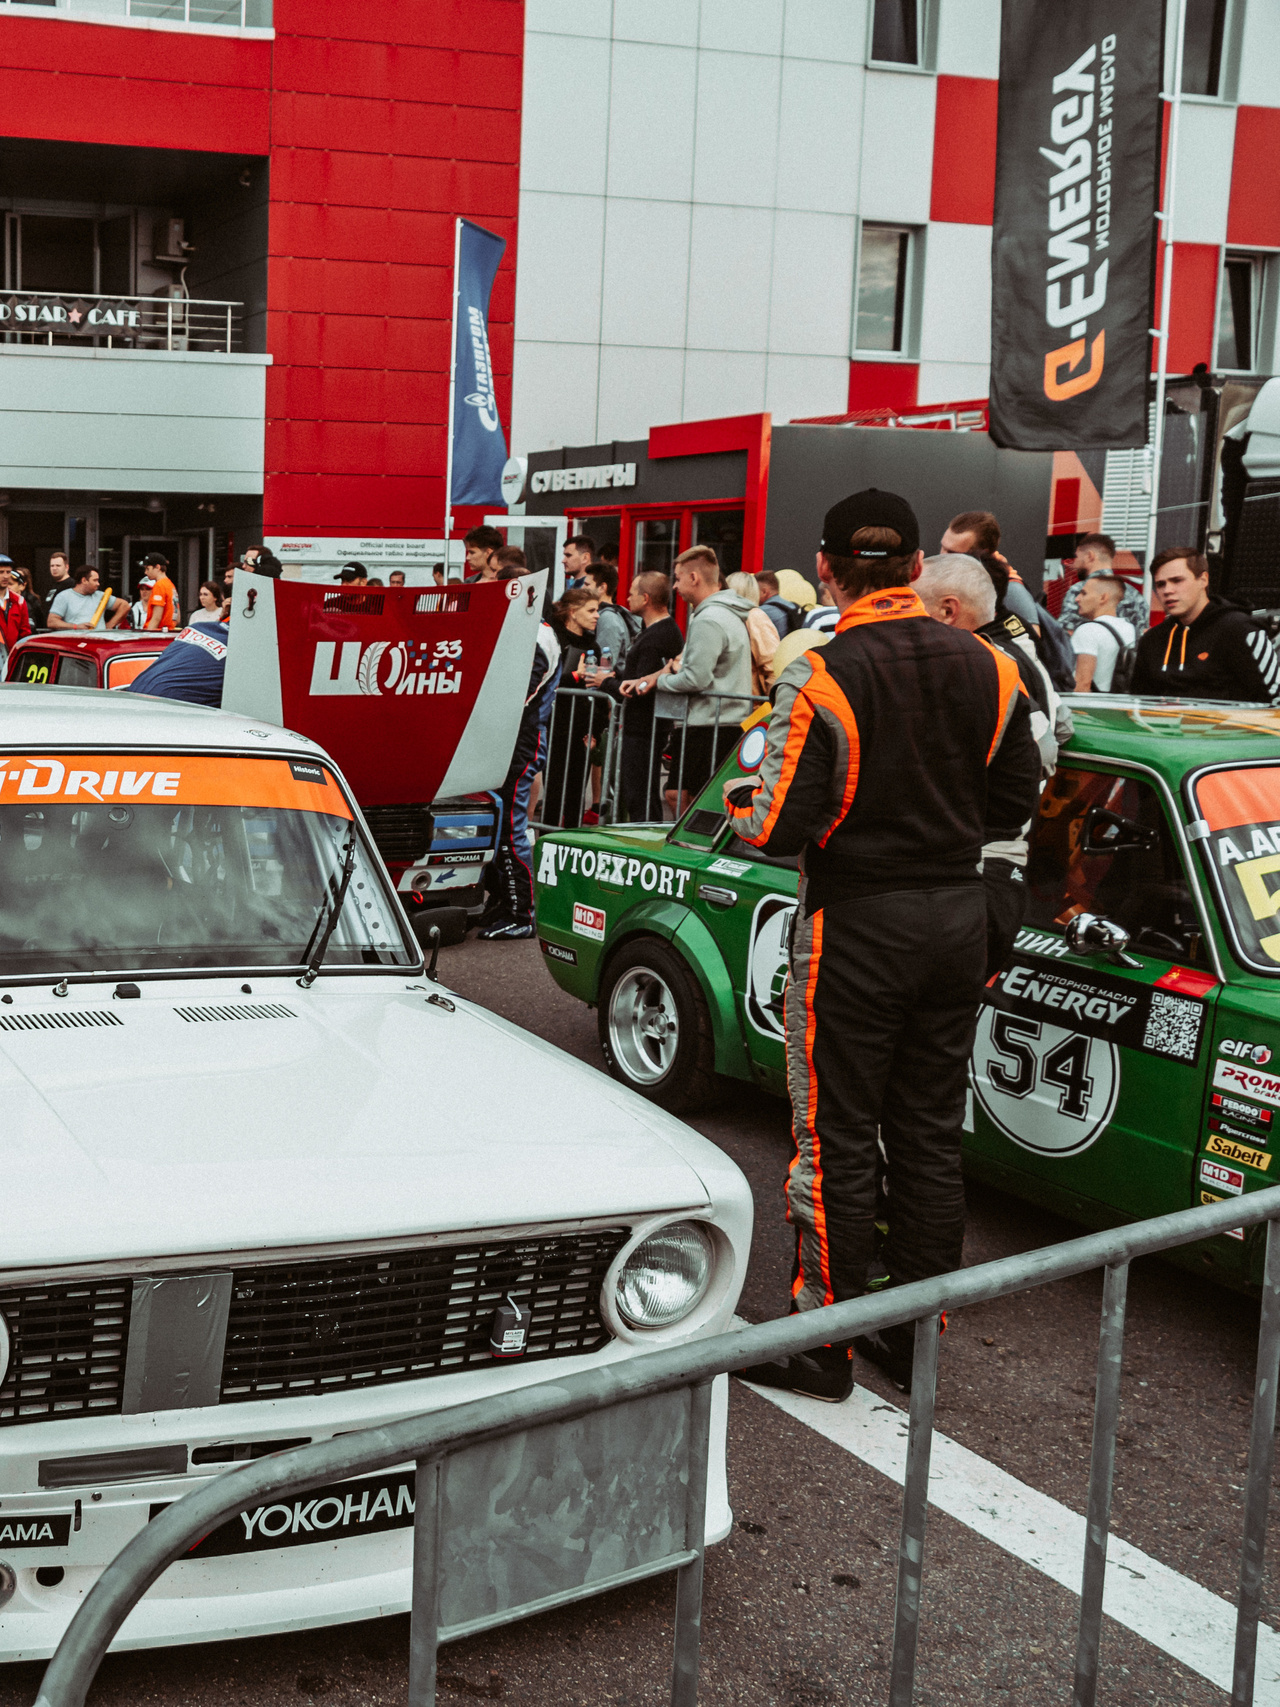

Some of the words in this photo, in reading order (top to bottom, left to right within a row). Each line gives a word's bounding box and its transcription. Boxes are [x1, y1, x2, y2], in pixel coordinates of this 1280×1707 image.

[14, 304, 67, 323] STAR
[87, 308, 141, 328] CAFE
[467, 305, 488, 393] ГАЗПРОМ
[530, 462, 637, 494] СУВЕНИРЫ
[359, 541, 383, 549] Official
[433, 639, 463, 658] 33
[293, 765, 321, 776] Historic
[444, 854, 480, 863] YOKOHAMA
[537, 842, 691, 899] AVTOEXPORT
[574, 905, 596, 925] M1D
[574, 924, 603, 939] RACING
[547, 945, 574, 962] YOKOHAMA
[1037, 972, 1096, 995] МОТОРНОЕ
[1097, 987, 1138, 1005] МАСЛО
[1219, 1039, 1253, 1058] elf
[986, 1009, 1095, 1122] 54
[1222, 1098, 1259, 1117] FERODO
[1222, 1109, 1257, 1125] RACING
[1219, 1122, 1266, 1144] Pipercross
[1211, 1137, 1264, 1167] Sabelt
[1203, 1163, 1229, 1181] M1D
[1202, 1176, 1240, 1194] RACING
[240, 1485, 415, 1540] YOKOHAM
